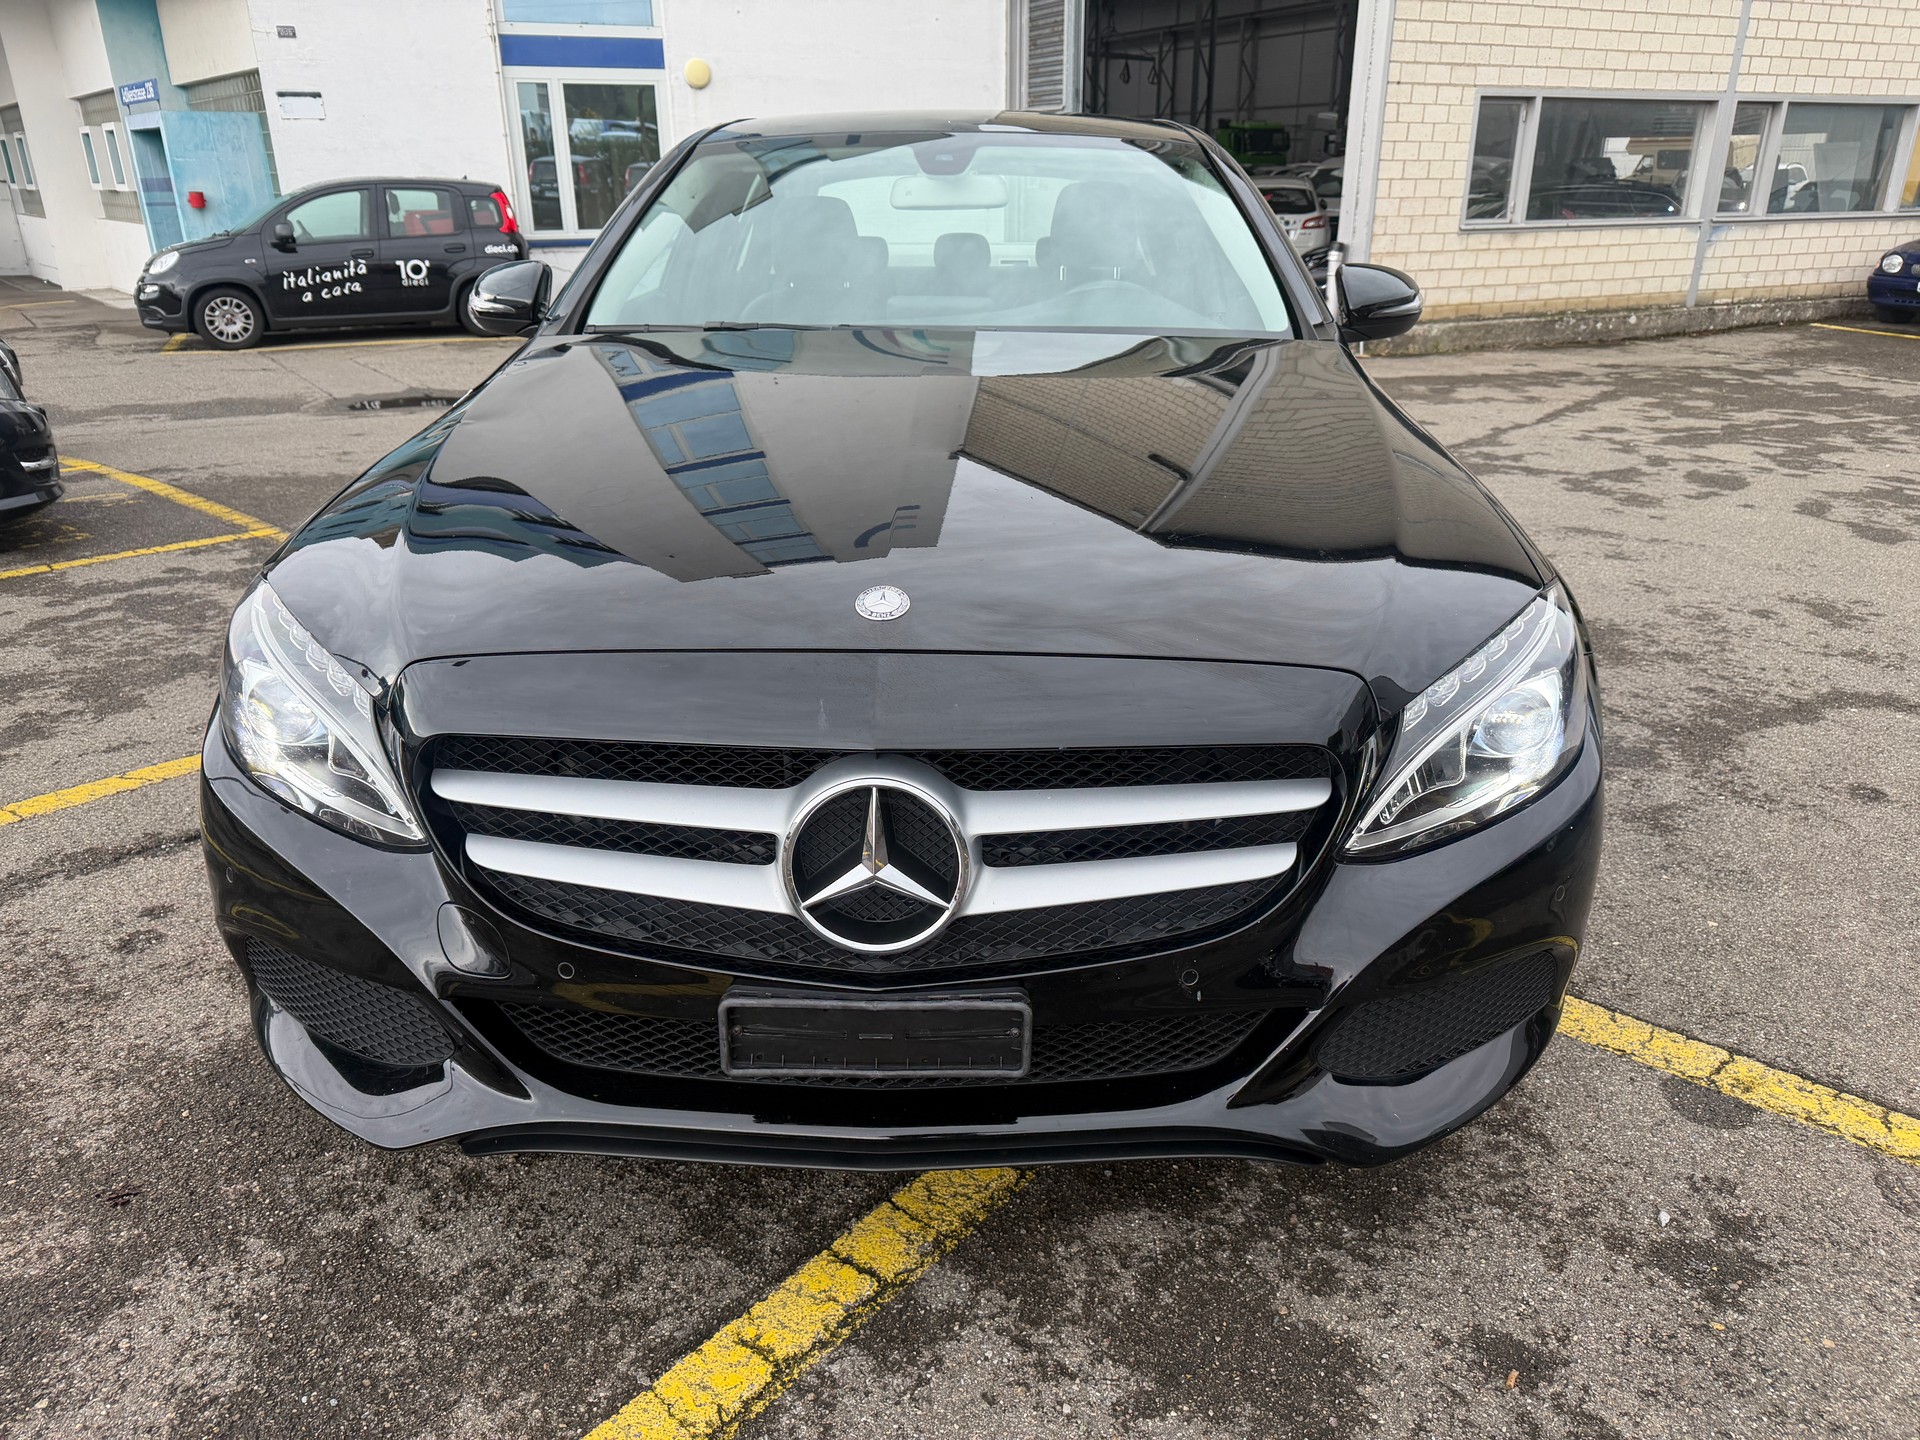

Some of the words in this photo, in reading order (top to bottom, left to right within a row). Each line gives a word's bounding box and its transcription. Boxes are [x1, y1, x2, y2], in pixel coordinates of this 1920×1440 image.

[484, 243, 519, 254] dieci.ch
[282, 259, 368, 290] italianità
[401, 278, 429, 287] dieci
[301, 291, 313, 303] a
[321, 281, 362, 299] casa
